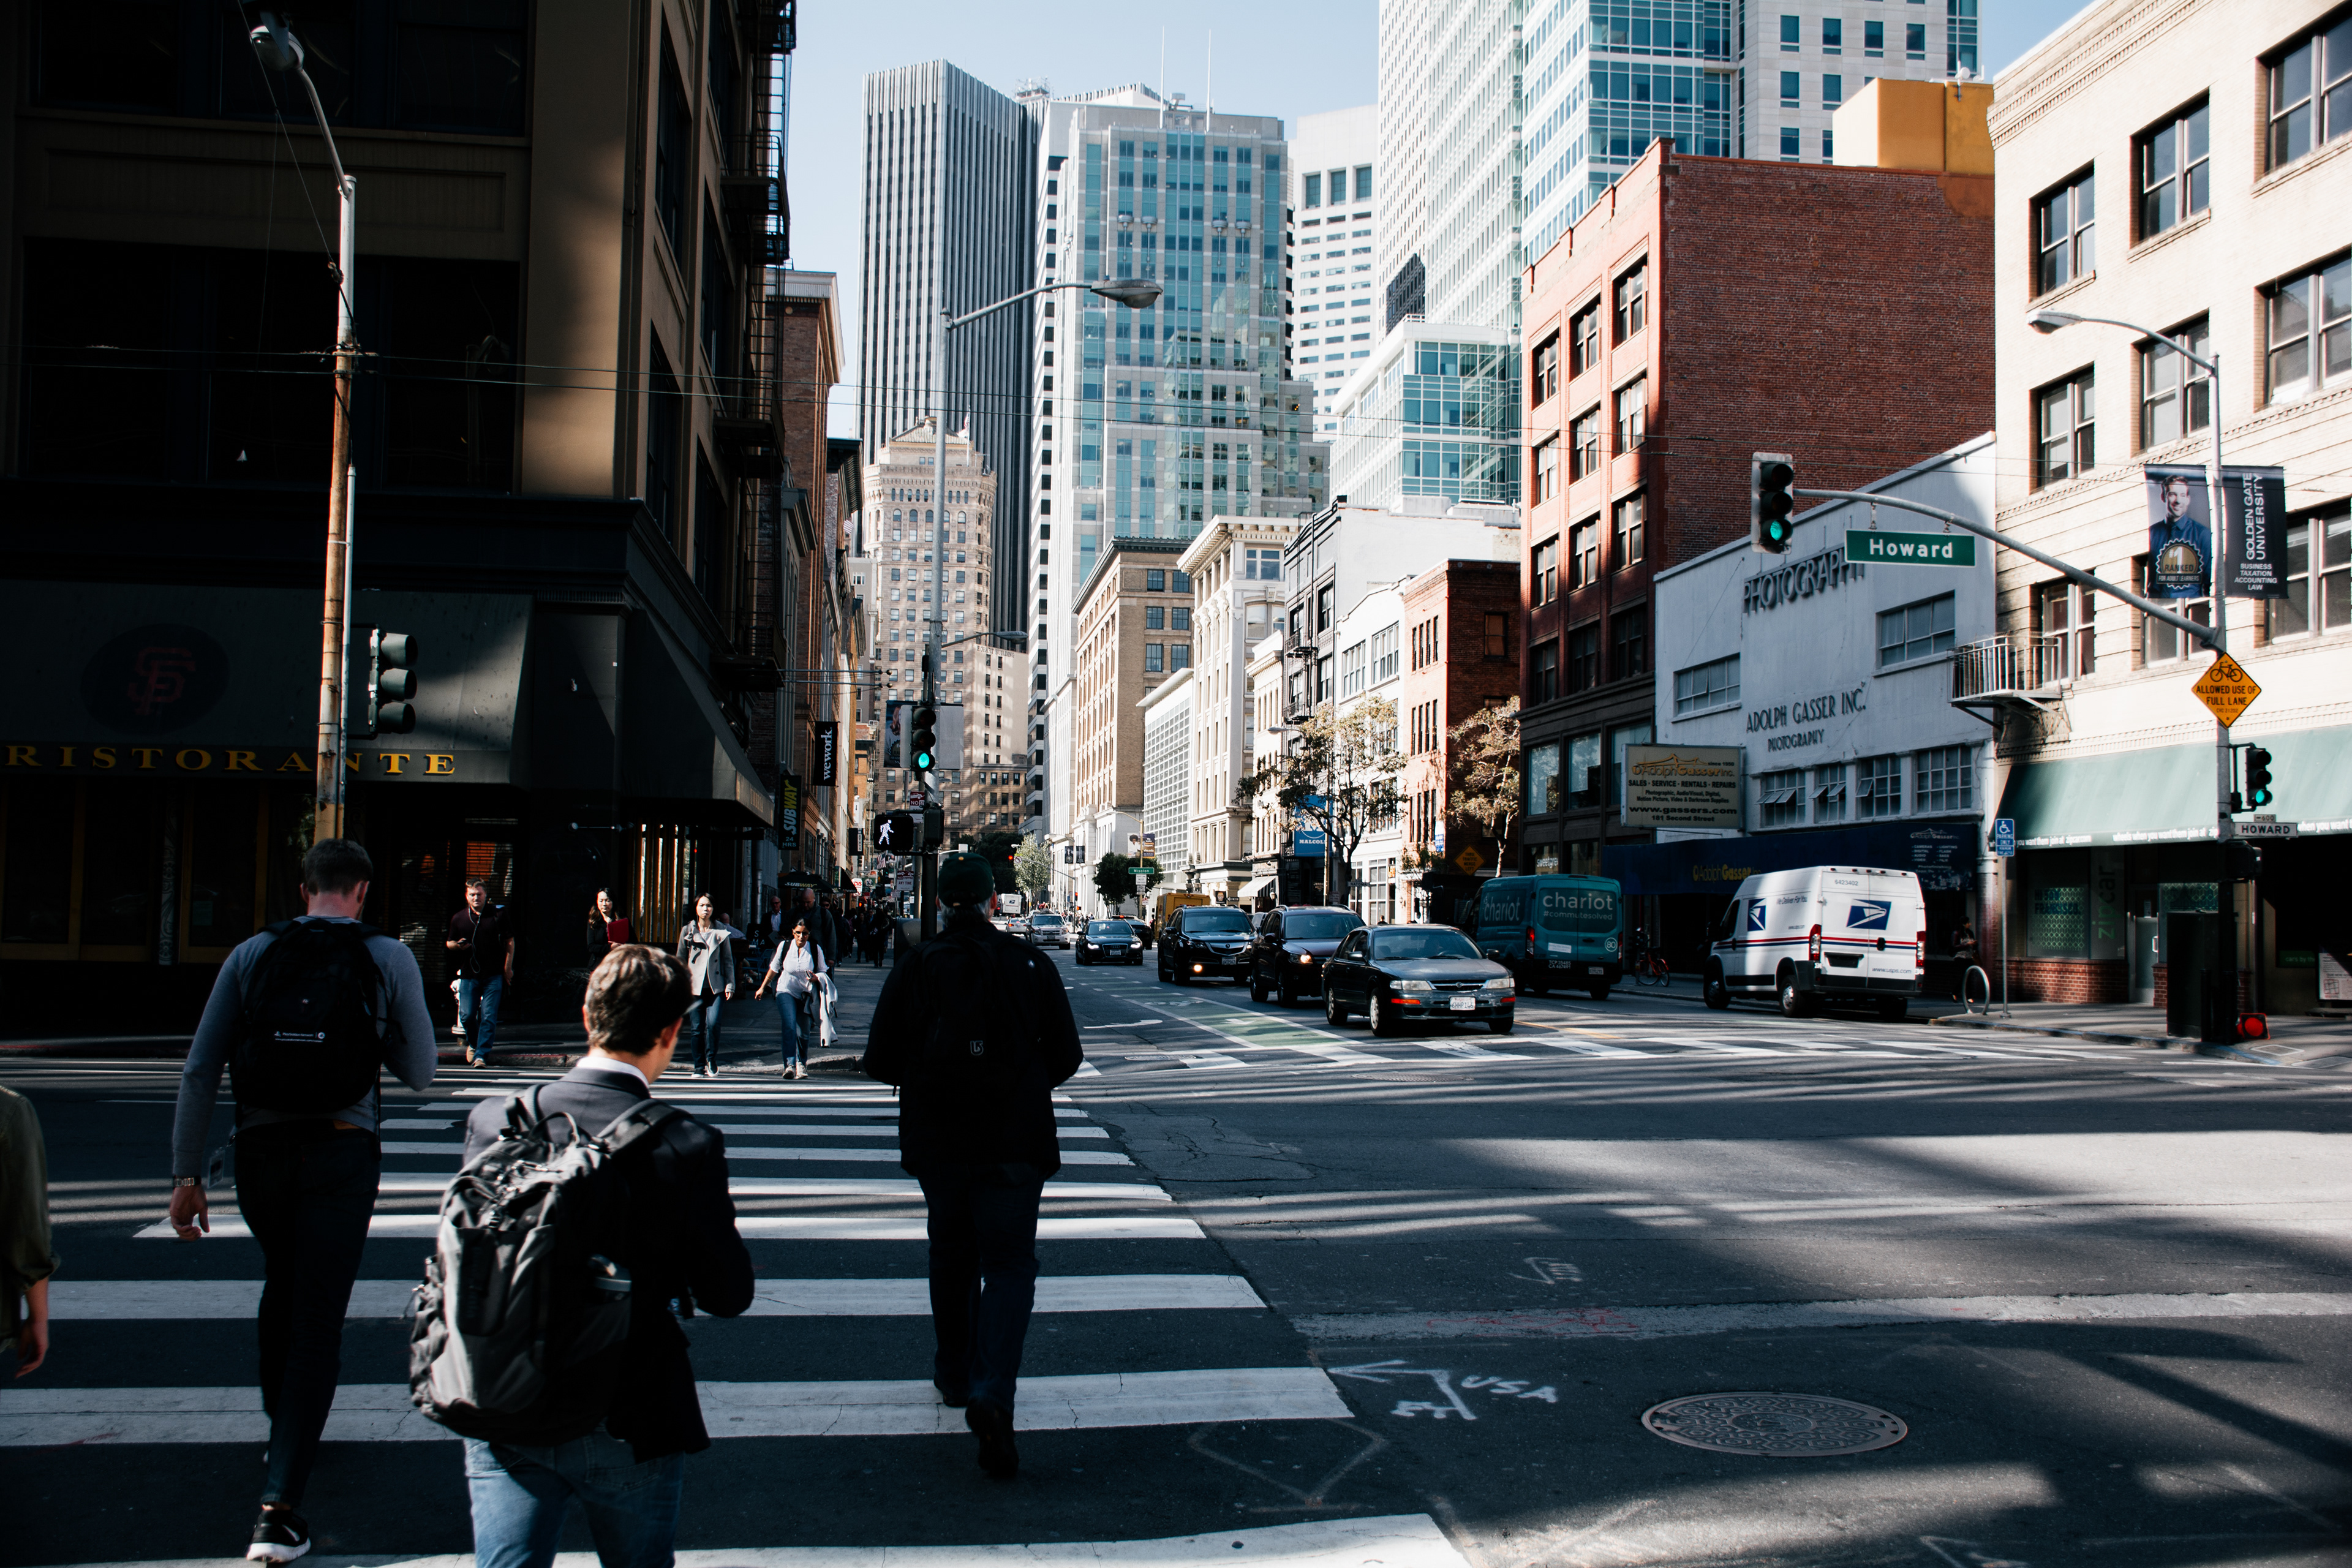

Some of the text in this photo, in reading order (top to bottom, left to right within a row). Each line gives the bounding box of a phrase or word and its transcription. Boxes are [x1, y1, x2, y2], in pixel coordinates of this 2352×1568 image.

[2242, 473, 2255, 560] GOLDEN GATE
[2253, 474, 2266, 560] UNIVERSITY
[1869, 539, 1953, 558] Howard
[1743, 547, 1864, 614] PHOTOGRAPH
[1746, 688, 1866, 733] ADOLPH GASSER INC.
[1768, 729, 1824, 752] PHOTOGRAPHY
[783, 779, 797, 835] SUBWAY
[2147, 832, 2158, 842] you
[2158, 830, 2172, 839] want
[2172, 829, 2187, 839] them
[2187, 828, 2199, 840] join
[2242, 825, 2290, 834] HOWARD
[2297, 821, 2316, 832] when
[2316, 823, 2330, 833] you
[2331, 820, 2348, 829] want
[1537, 856, 1558, 869] sweetgre
[1542, 892, 1613, 910] chariot
[2035, 889, 2060, 900] HI SAN
[2092, 865, 2122, 940] zipcar
[1483, 896, 1521, 922] chariot
[1544, 911, 1613, 920] #commutesolved
[1461, 1375, 1558, 1403] USA
